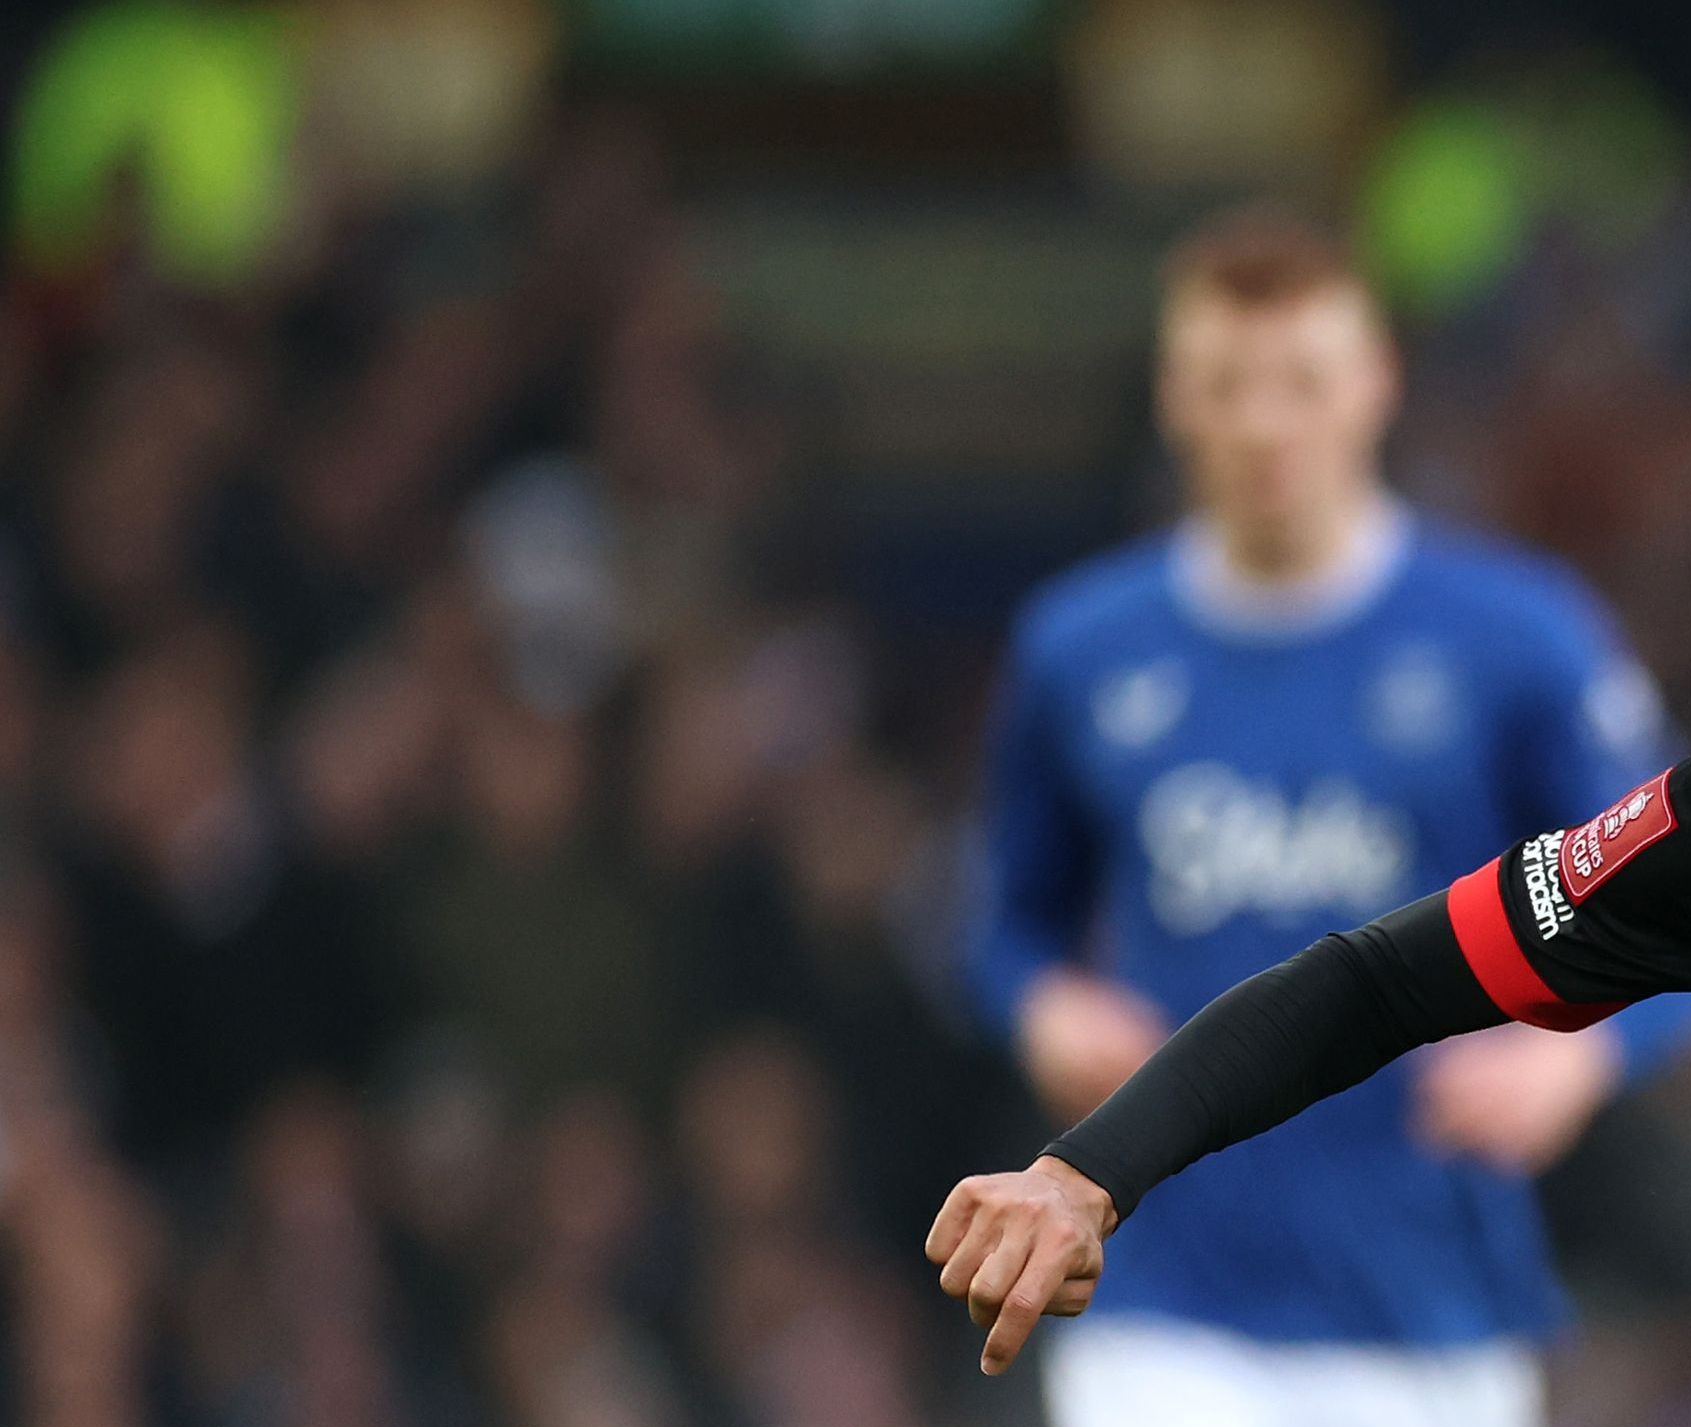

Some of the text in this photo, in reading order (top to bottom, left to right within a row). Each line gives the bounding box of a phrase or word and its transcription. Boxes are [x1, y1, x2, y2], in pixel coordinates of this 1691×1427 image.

[1572, 840, 1592, 877] CUP
[1587, 814, 1605, 868] rates
[1524, 861, 1560, 941] racism
